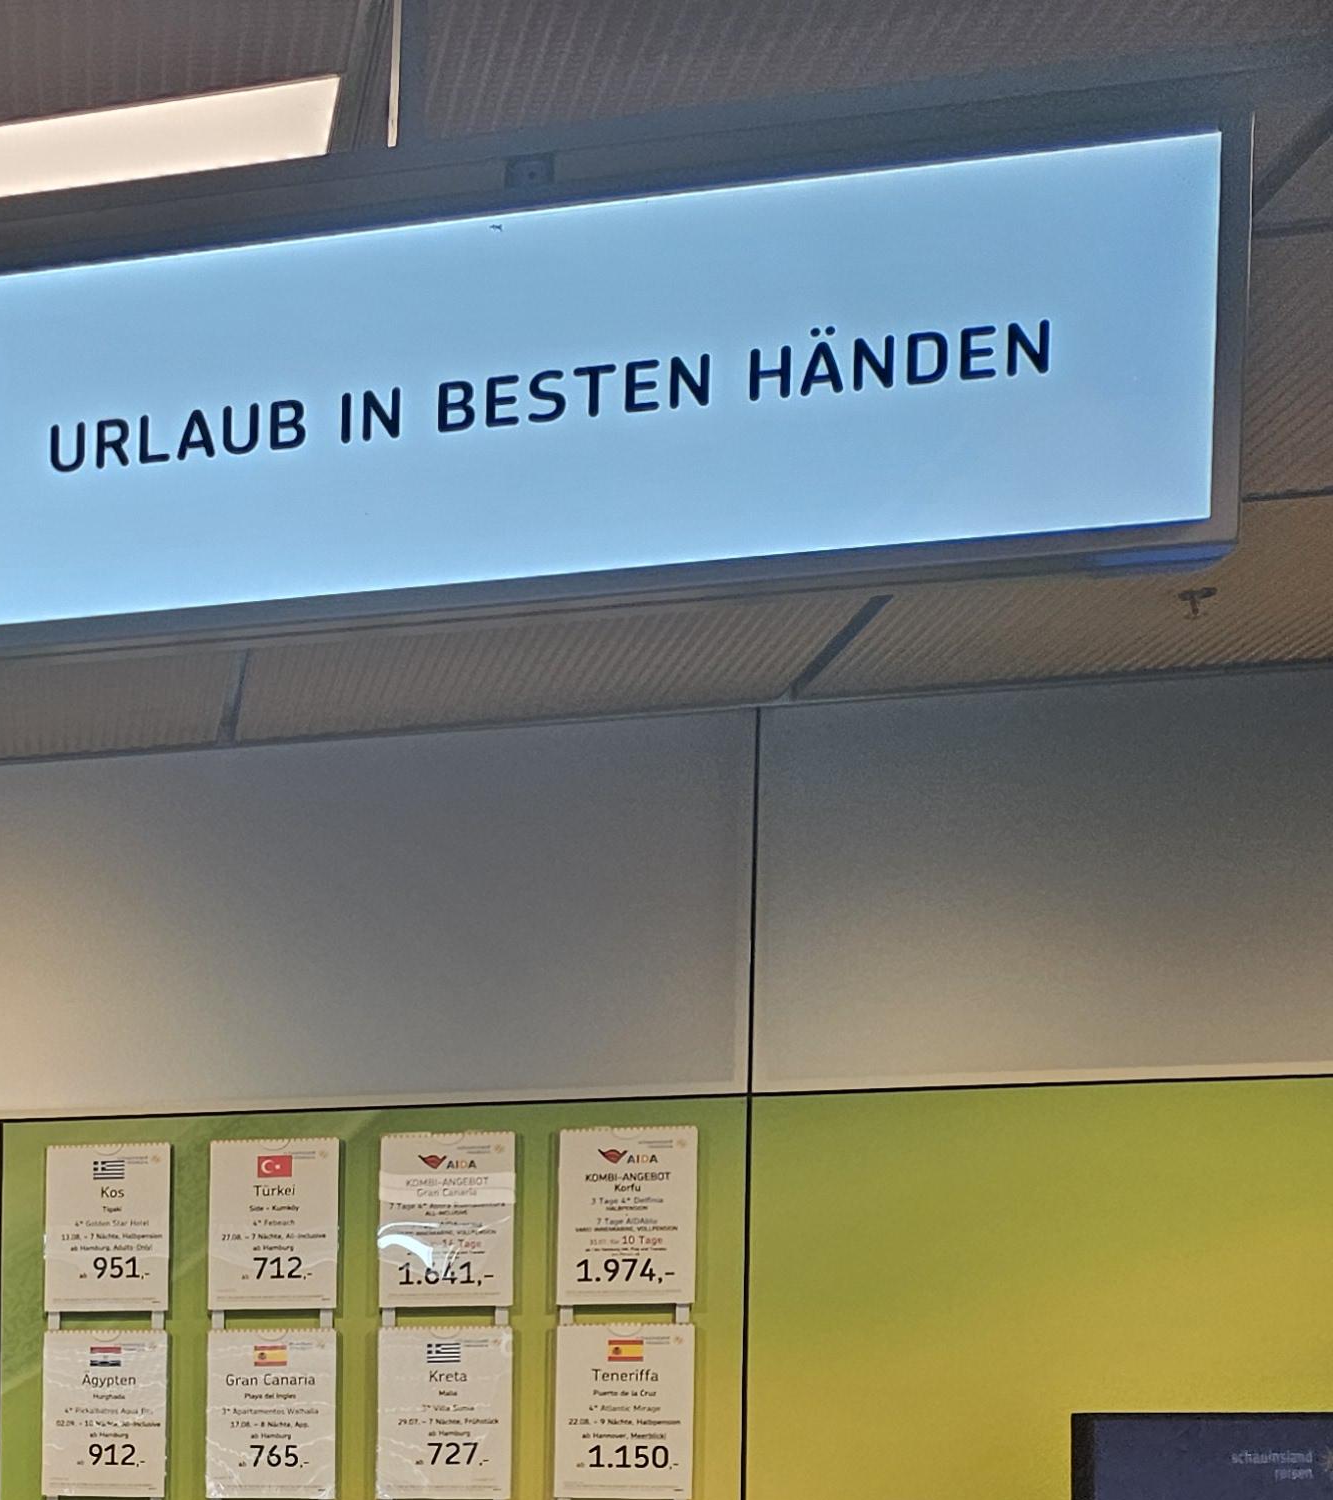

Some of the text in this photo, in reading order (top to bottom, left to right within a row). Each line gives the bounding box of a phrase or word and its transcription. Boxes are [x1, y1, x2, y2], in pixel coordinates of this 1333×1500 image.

[49, 319, 1051, 472] URLAUB IN BESTEN HÄNDEN
[446, 1160, 477, 1169] AIDA
[627, 1155, 658, 1164] AIDA
[406, 1177, 489, 1187] KOMBI-ANGEBOT
[585, 1172, 671, 1182] KOMBI-ANGEBOT
[100, 1186, 125, 1198] Kos
[253, 1184, 295, 1197] Türkei
[417, 1188, 477, 1198] Gran Canaria
[614, 1184, 641, 1192] Korfu
[622, 1235, 663, 1246] 10 Tage
[93, 1256, 150, 1280] 951,-
[253, 1257, 313, 1280] 712,-
[576, 1258, 675, 1283] 1.974,-
[82, 1370, 136, 1388] Ägypten
[226, 1374, 316, 1386] Gran Canaria
[429, 1371, 468, 1382] Kreta
[592, 1369, 659, 1382] Teneriffa
[89, 1444, 145, 1467] 912,-
[250, 1445, 309, 1468] 765,-
[589, 1445, 679, 1470] 1.150,-
[1232, 1450, 1313, 1465] schauinsland
